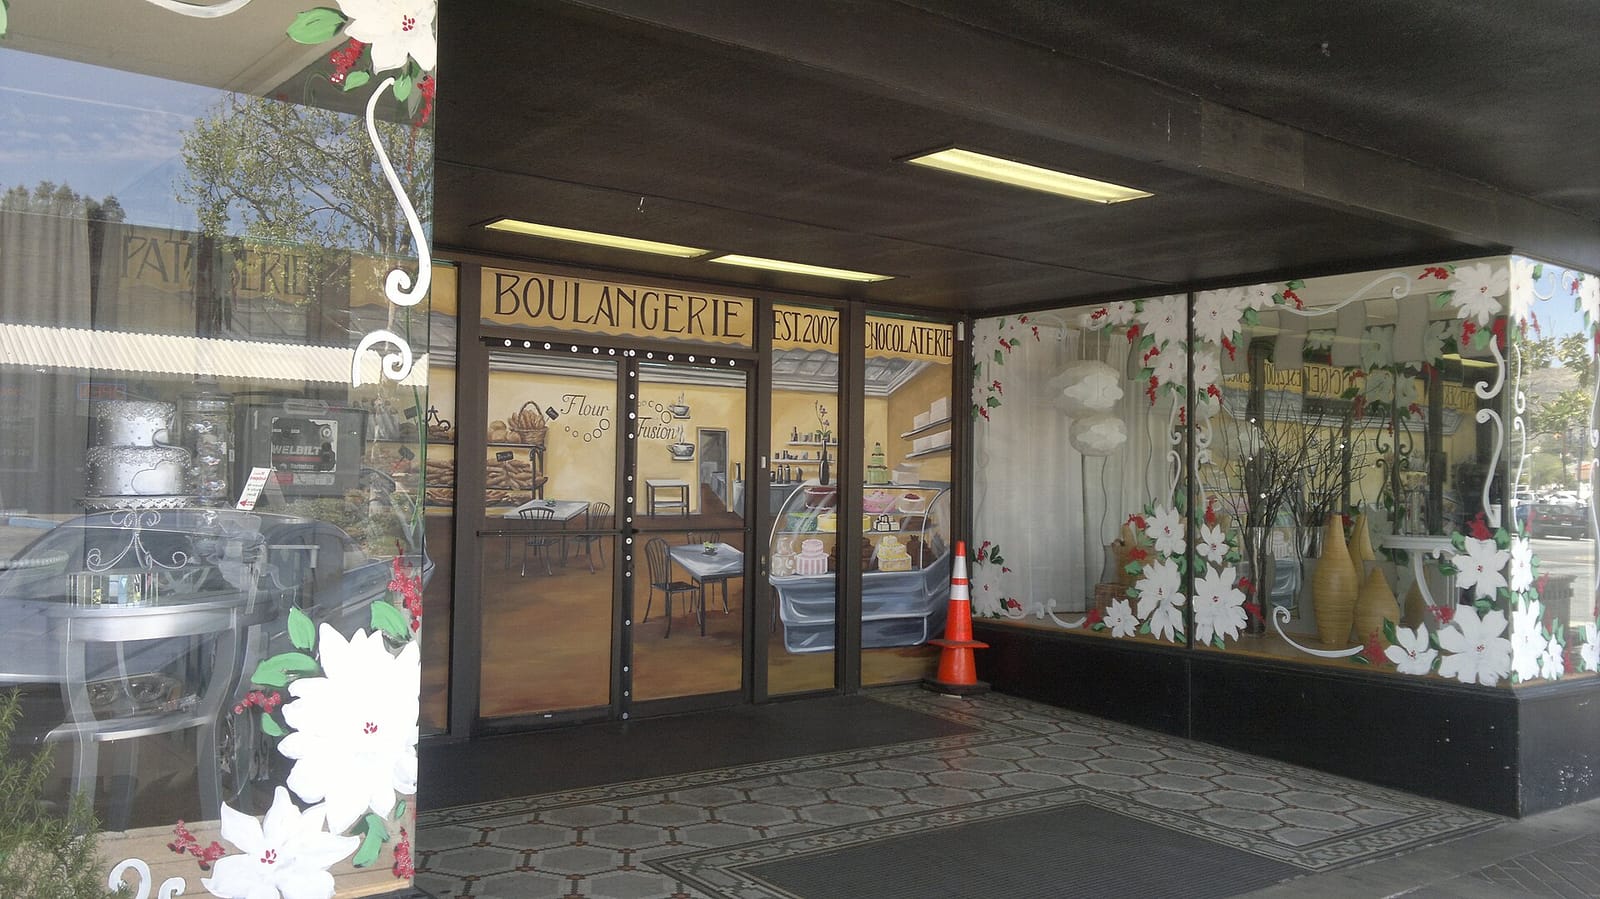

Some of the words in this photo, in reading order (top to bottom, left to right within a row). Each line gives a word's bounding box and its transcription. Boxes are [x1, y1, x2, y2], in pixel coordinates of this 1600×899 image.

[121, 233, 311, 296] PATERIE
[494, 272, 745, 338] BOULANGERIE
[864, 321, 953, 358] CHOCOLATERIE
[560, 393, 609, 417] Flour
[636, 416, 678, 441] Fusion
[272, 444, 322, 456] WELBILT
